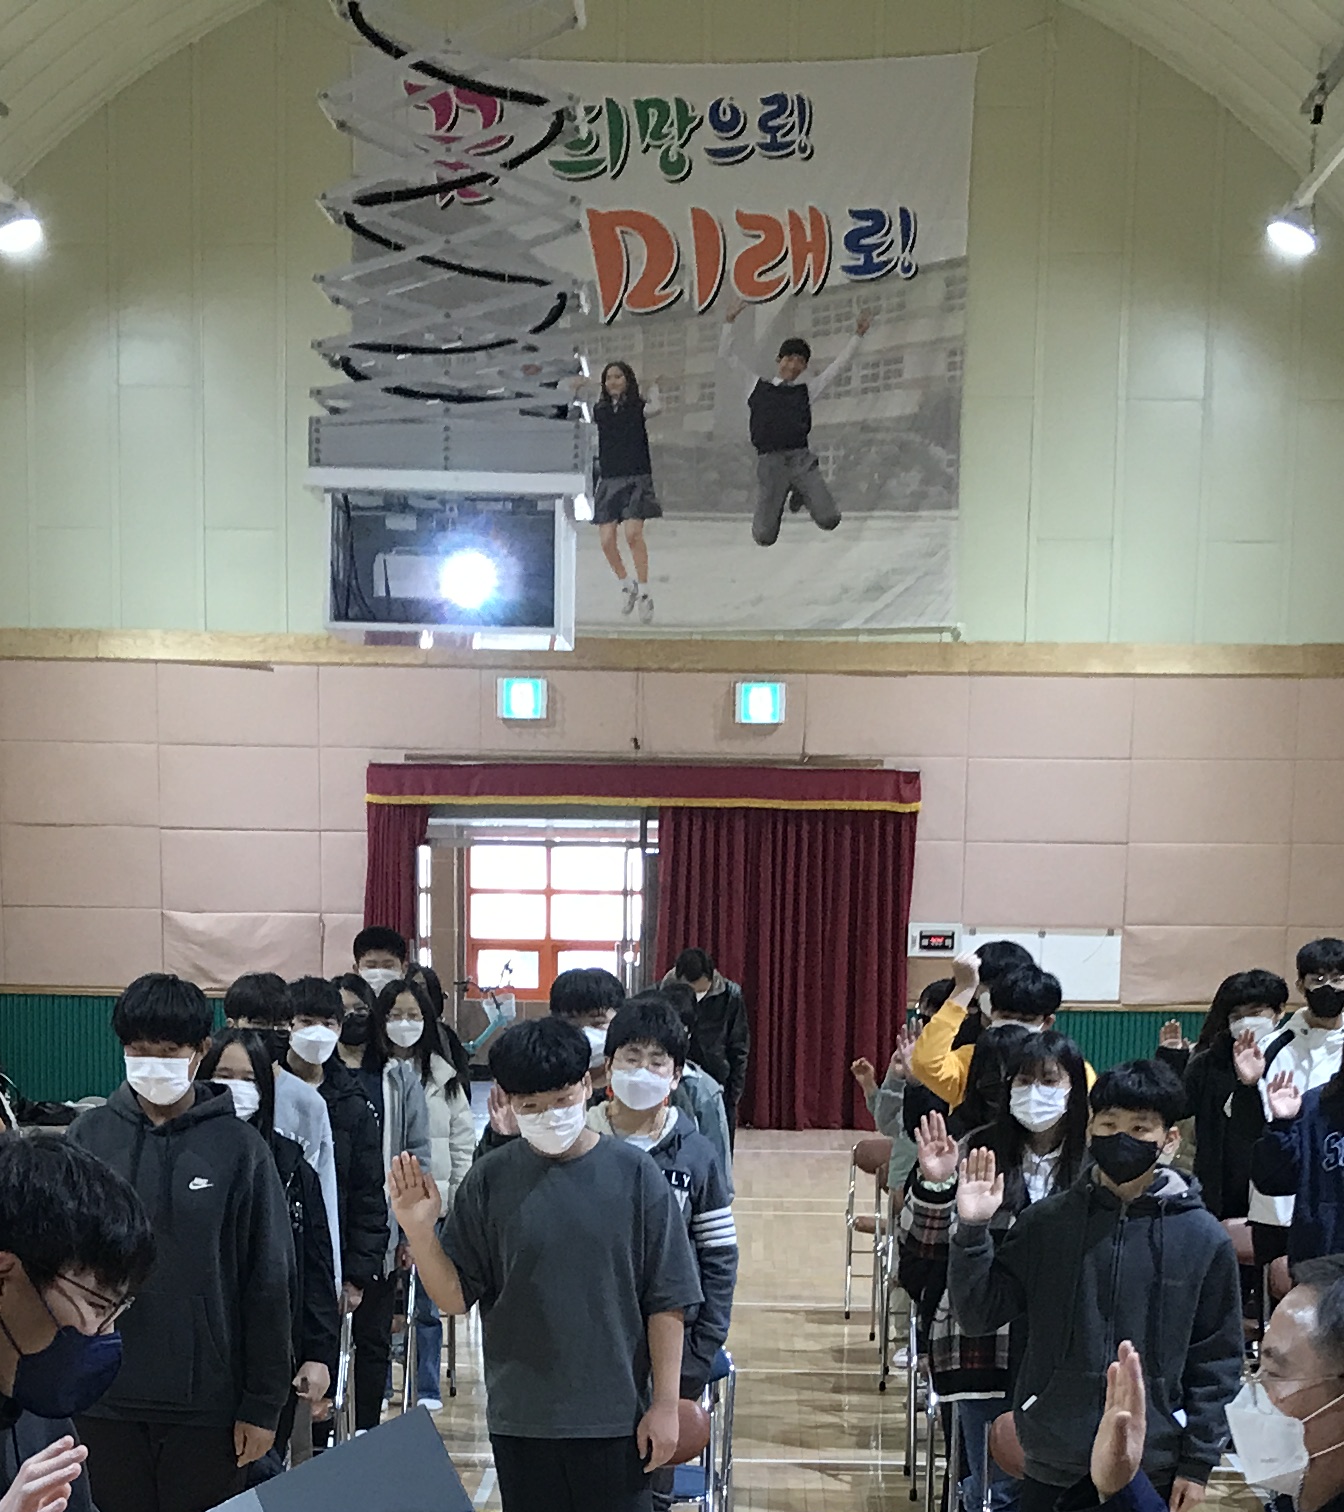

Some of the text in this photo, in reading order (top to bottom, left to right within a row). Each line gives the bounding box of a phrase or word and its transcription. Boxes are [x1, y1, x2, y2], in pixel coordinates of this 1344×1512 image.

[548, 93, 815, 183] 희망으로!
[586, 205, 919, 325] 미래로!
[661, 1169, 691, 1188] LY
